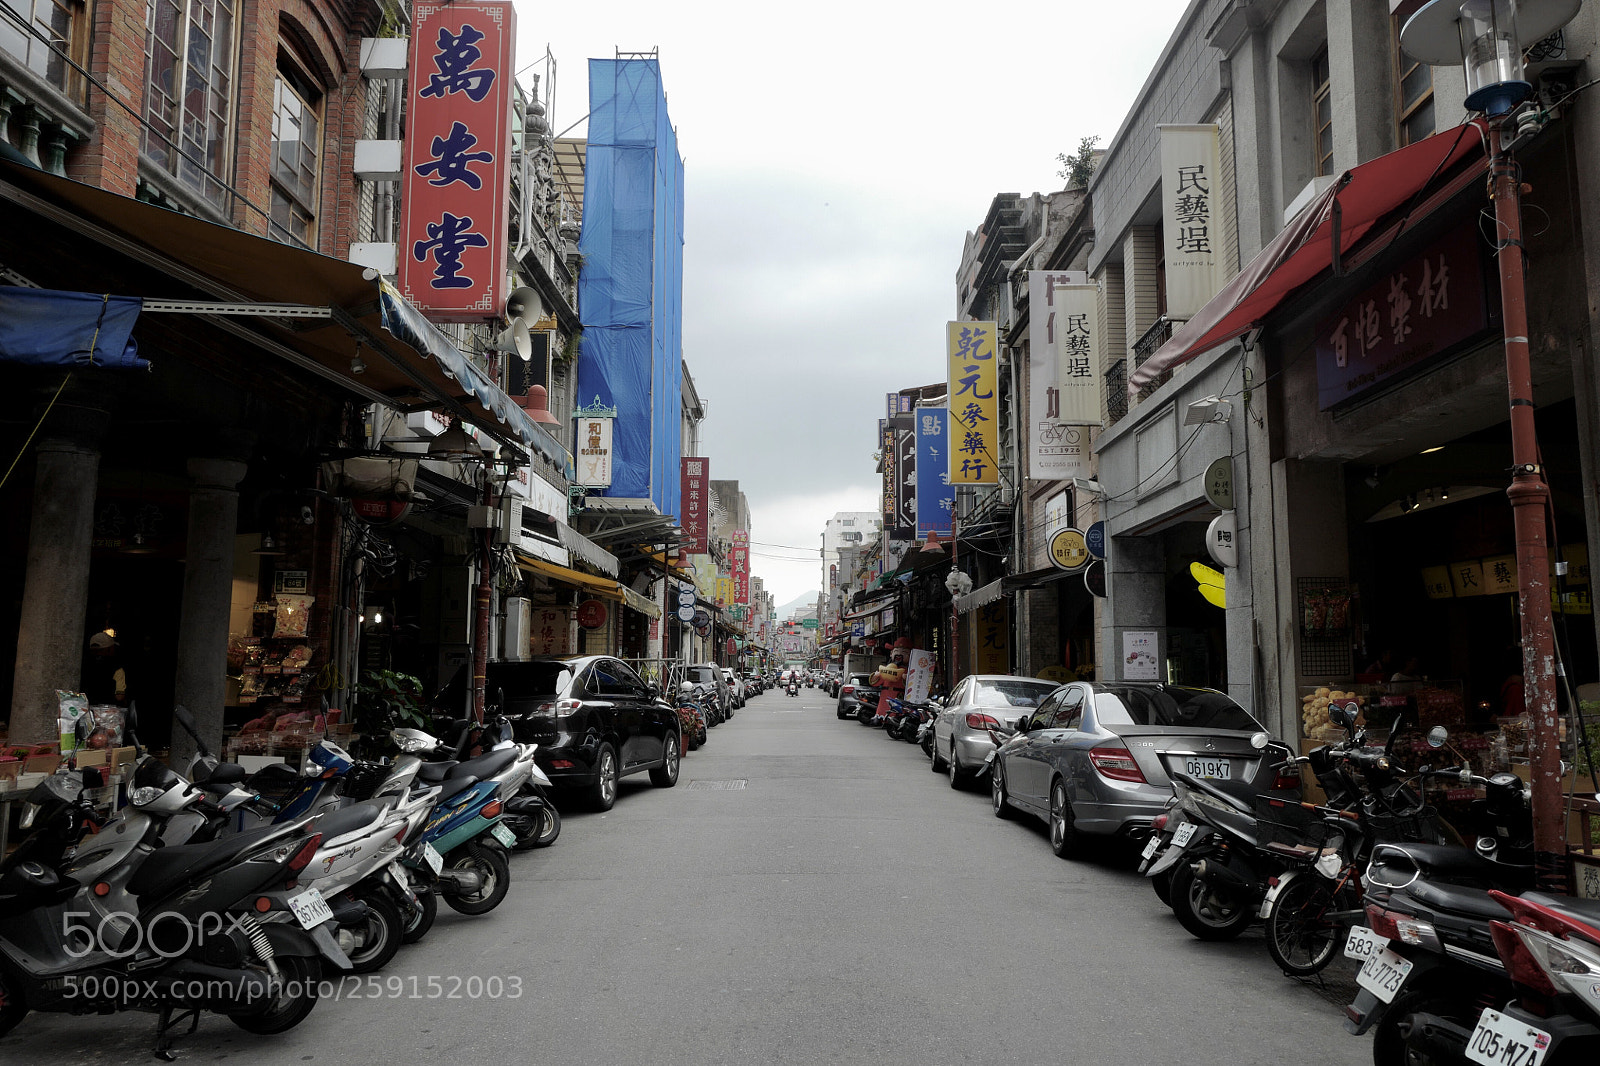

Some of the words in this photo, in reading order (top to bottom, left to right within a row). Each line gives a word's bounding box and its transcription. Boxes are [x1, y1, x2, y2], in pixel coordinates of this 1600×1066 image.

[413, 24, 497, 289] 萬安堂
[1174, 164, 1212, 254] 民藝埕
[954, 327, 994, 481] 乾元參藥行
[1065, 313, 1093, 378] 民藝埕
